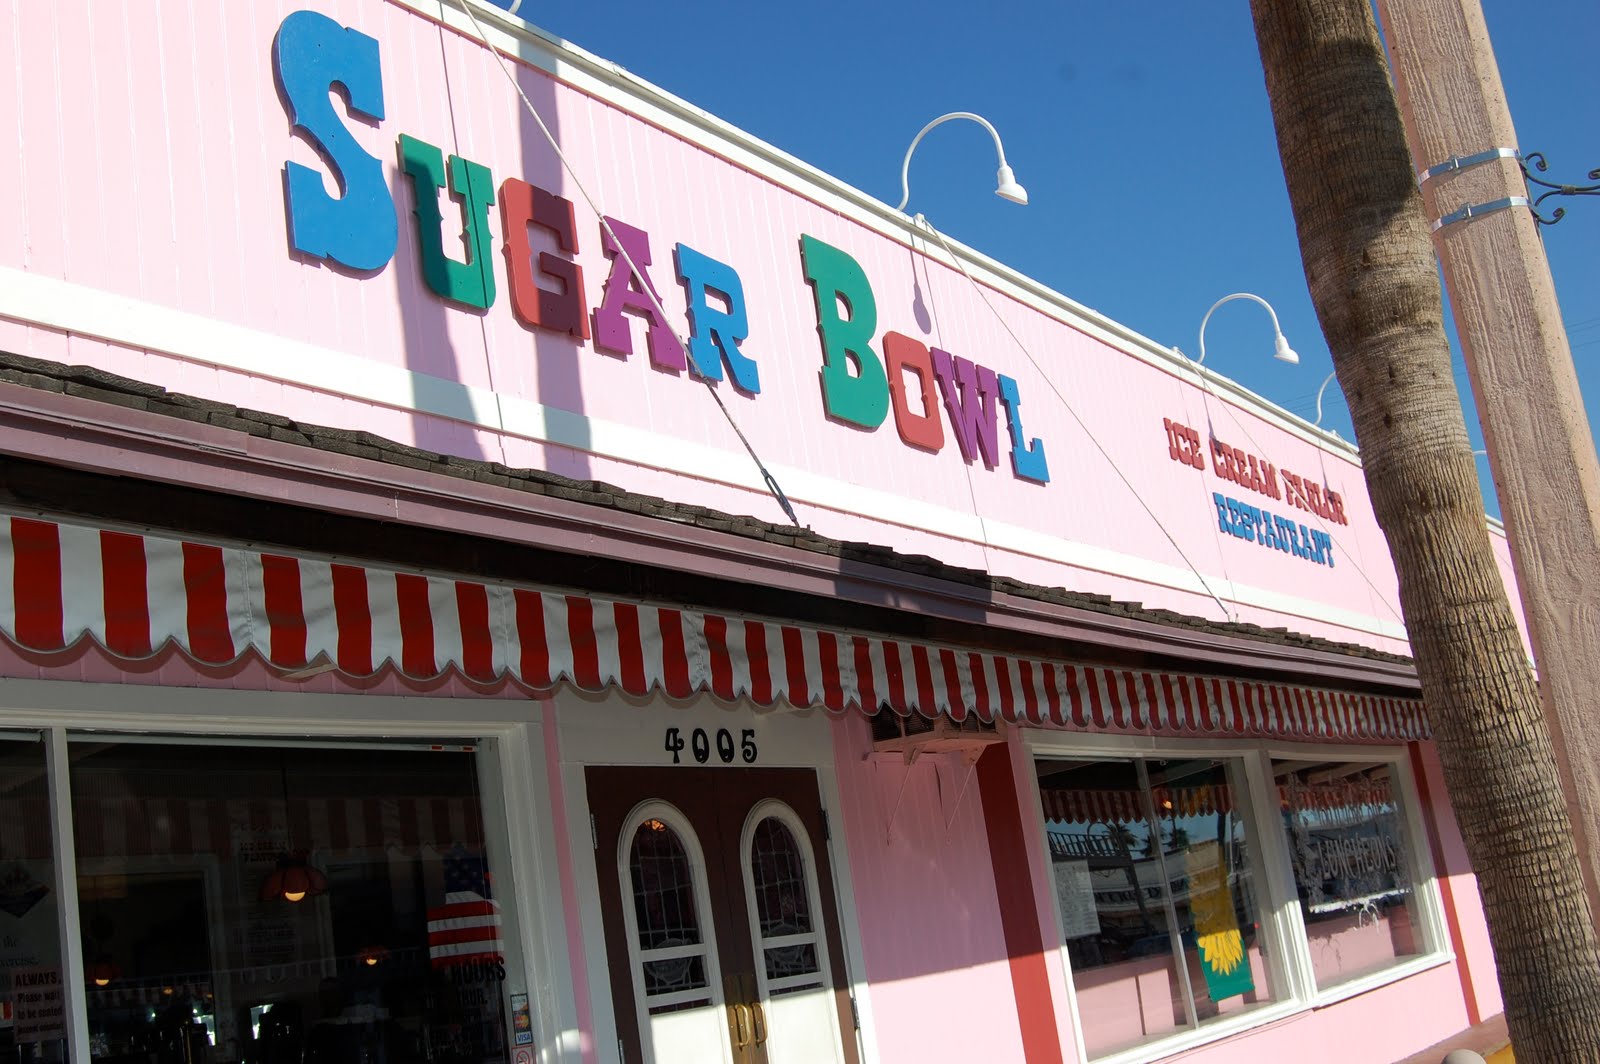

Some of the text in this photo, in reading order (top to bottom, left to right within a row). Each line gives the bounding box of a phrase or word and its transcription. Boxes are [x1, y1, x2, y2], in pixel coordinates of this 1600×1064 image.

[272, 9, 1049, 483] SUGAR BOWL
[1163, 417, 1348, 526] ICE CREAM PARLOR
[1212, 492, 1334, 568] RESTAURANT
[665, 728, 758, 764] 4005
[1317, 831, 1397, 880] LUNCHEONS
[451, 956, 507, 985] HOURS
[17, 992, 42, 1003] Please
[517, 1034, 531, 1043] VISA
